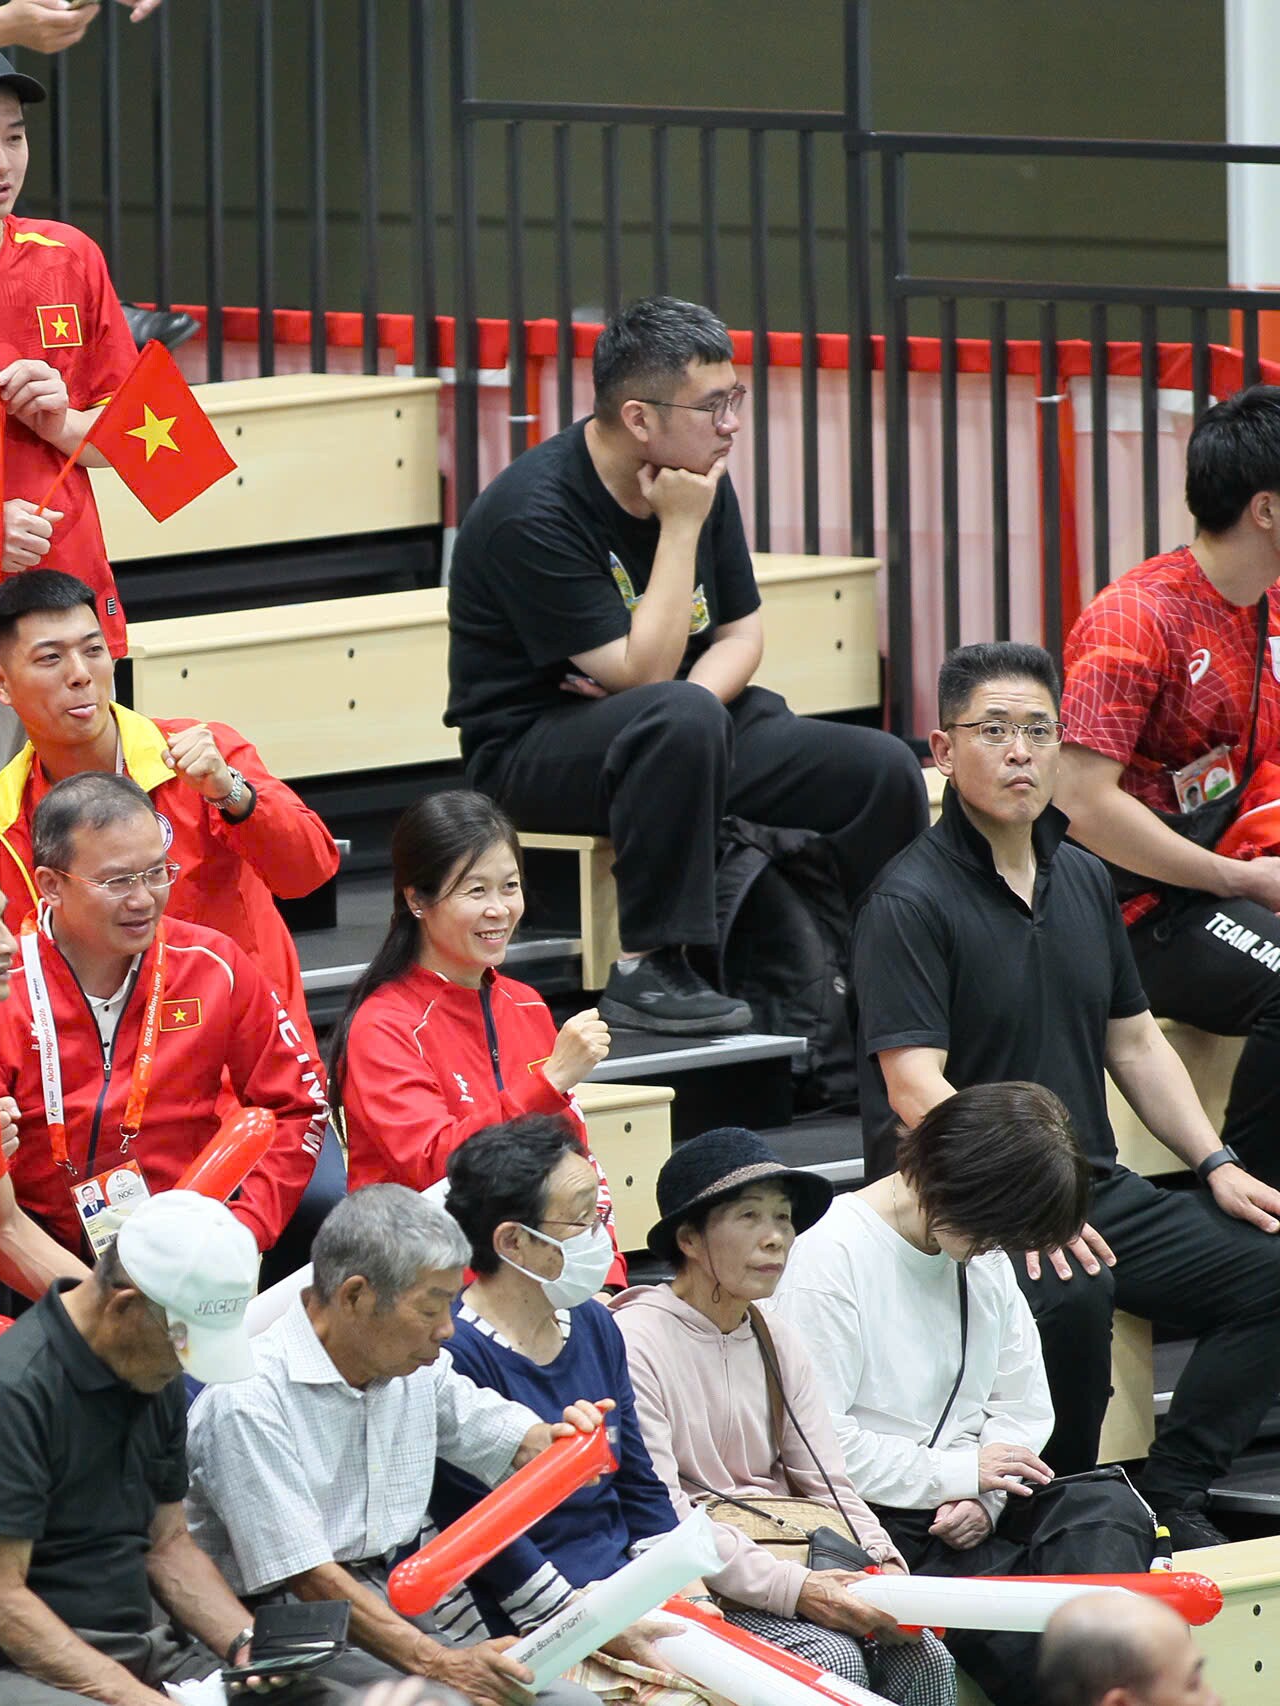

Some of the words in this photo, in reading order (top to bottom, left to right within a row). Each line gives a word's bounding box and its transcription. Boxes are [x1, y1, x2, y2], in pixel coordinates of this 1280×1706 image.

[1204, 911, 1261, 953] TEAM
[143, 1026, 154, 1047] 2026
[117, 1188, 135, 1201] NOC
